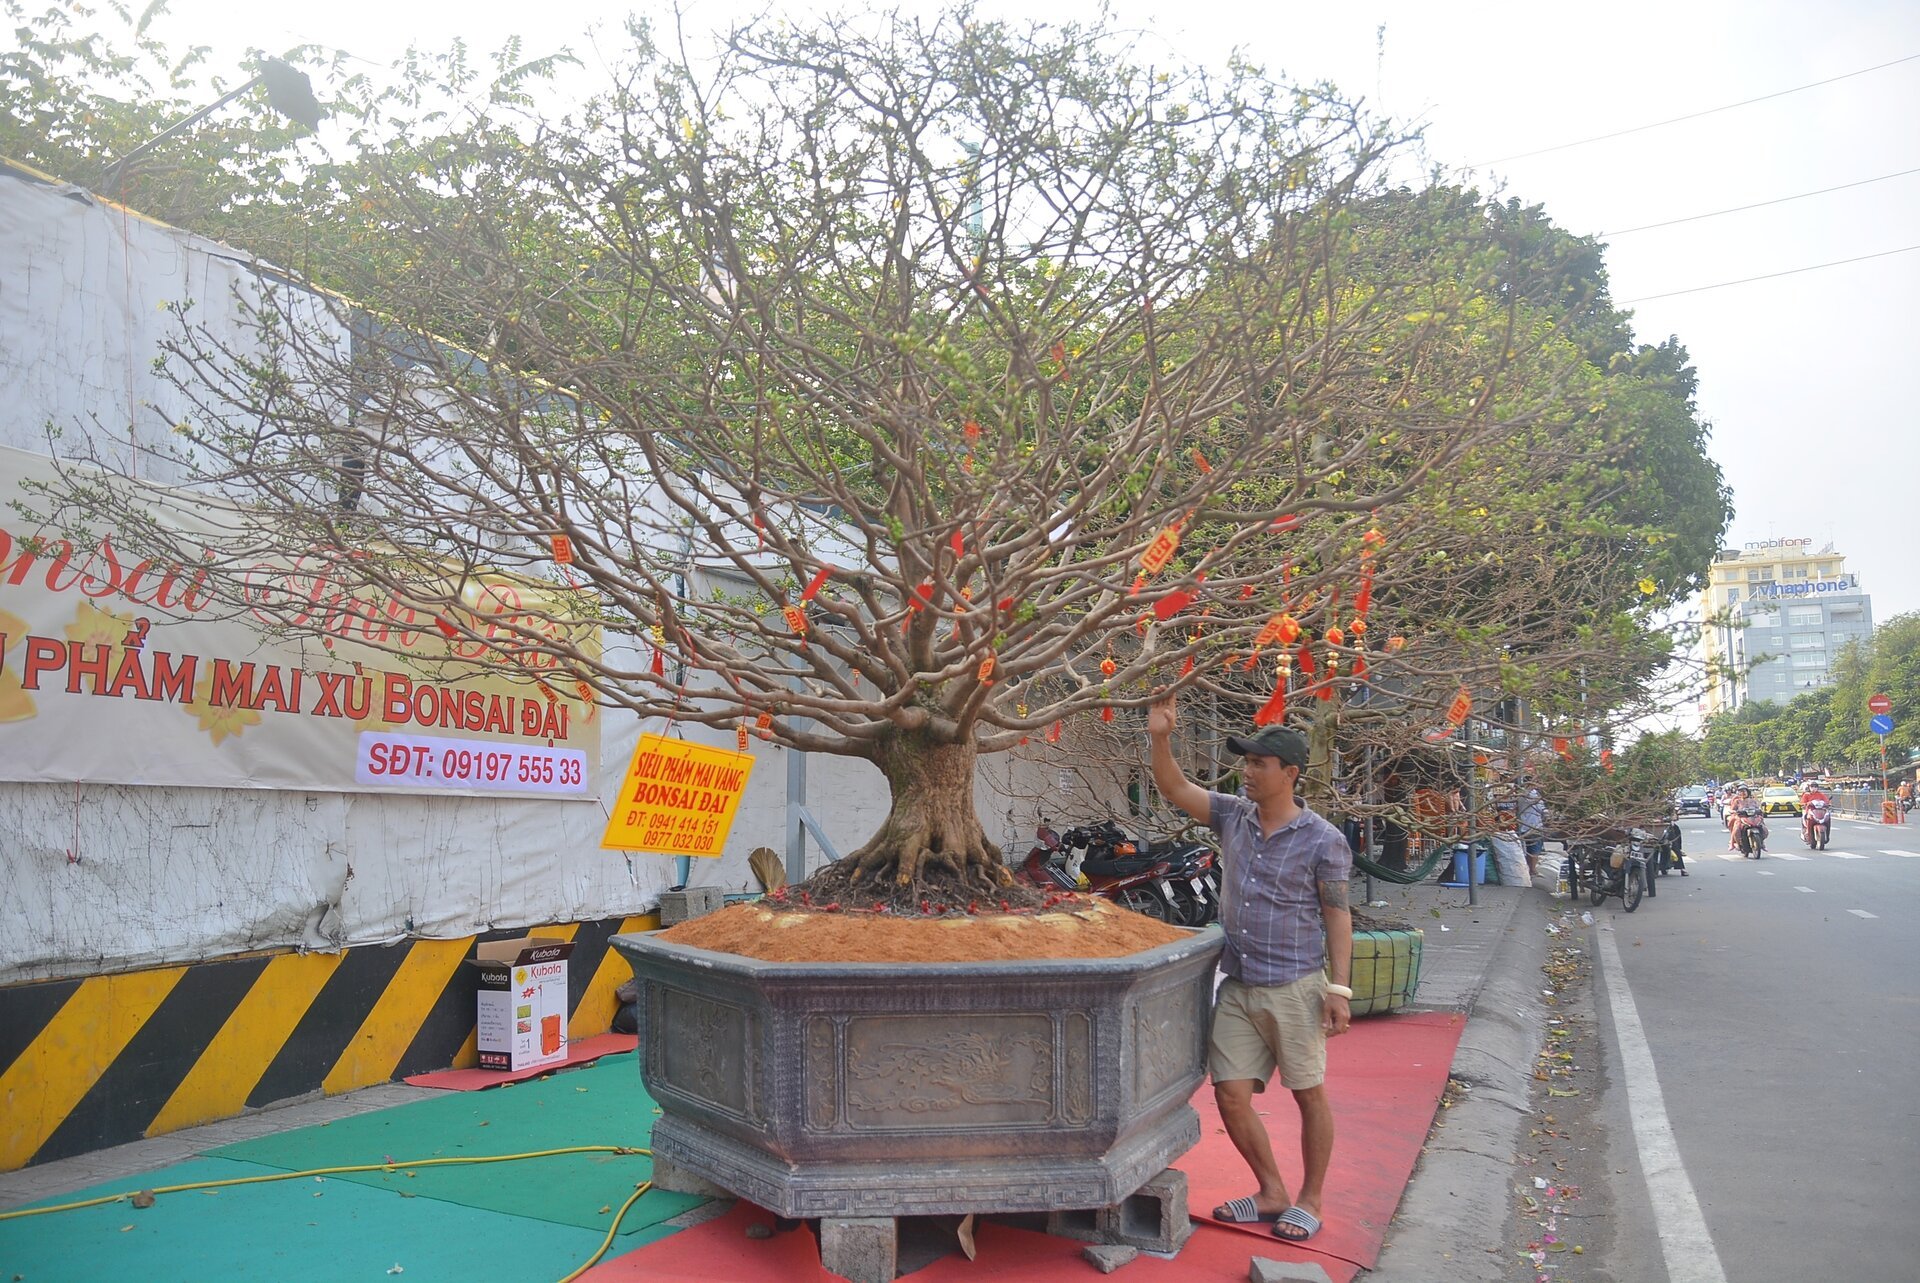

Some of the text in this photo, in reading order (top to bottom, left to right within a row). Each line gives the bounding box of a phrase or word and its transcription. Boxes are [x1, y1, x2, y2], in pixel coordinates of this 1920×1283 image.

[1744, 537, 1812, 550] mobifone
[21, 617, 199, 704] PHẨM
[208, 658, 301, 714] MAI
[382, 672, 515, 735] BONSAI
[521, 699, 569, 748] ĐẠI
[368, 742, 581, 786] SĐT: 09197 555 33
[634, 747, 744, 793] SIÊU PHẨM MAI VÀNG
[632, 782, 729, 818] BONSAI ĐẠI
[626, 811, 719, 835] ĐT: 0941 414 151
[643, 831, 714, 850] 0977 032 030
[530, 948, 560, 960] Kubota
[481, 972, 508, 982] Kubota
[531, 964, 561, 978] Kubota
